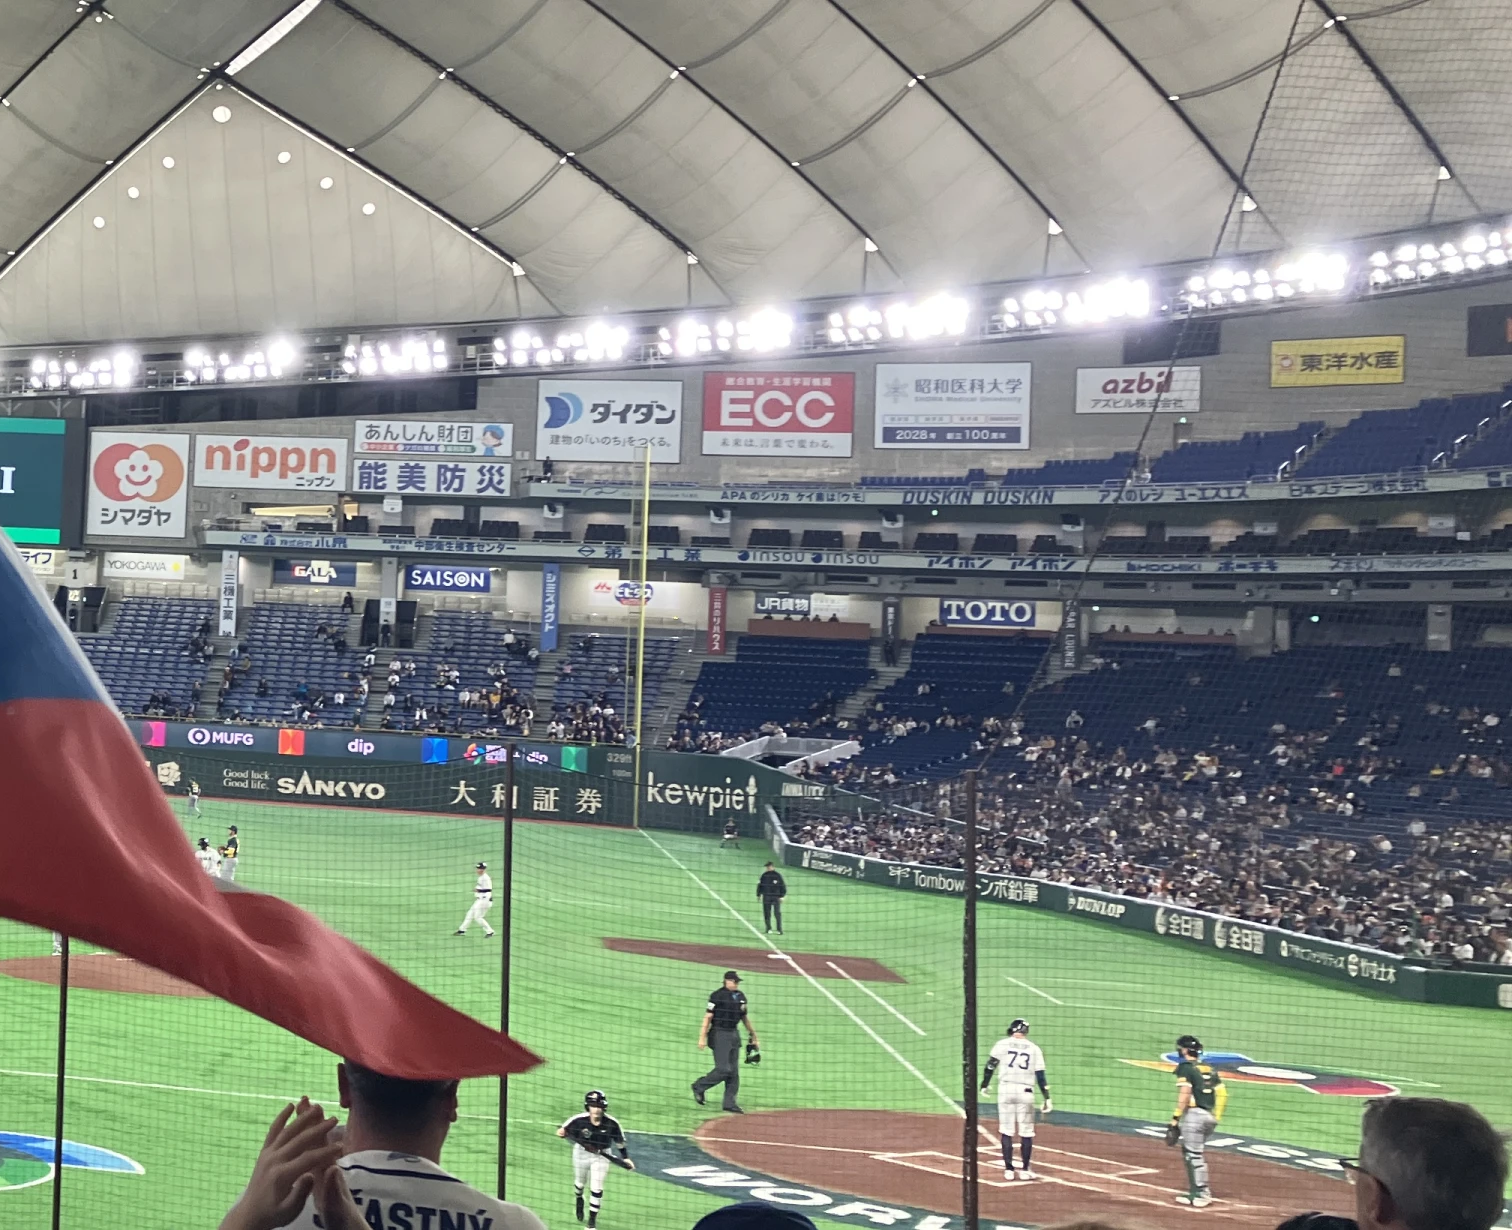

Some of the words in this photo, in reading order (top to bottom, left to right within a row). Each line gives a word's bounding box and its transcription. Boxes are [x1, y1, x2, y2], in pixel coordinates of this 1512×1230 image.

[1300, 351, 1399, 373] 東洋水産
[915, 378, 1023, 394] 昭和医科大学
[1102, 371, 1174, 394] azbil
[590, 400, 676, 424] ダイダン
[720, 390, 835, 428] ECC
[365, 423, 473, 442] あんしん財団
[205, 438, 336, 479] nippn
[295, 475, 335, 488] ニップン
[358, 461, 506, 494] 能美防災
[902, 490, 973, 505] DUSKIN
[983, 490, 1055, 505] DUSKIN
[100, 506, 172, 527] シマダヤ
[72, 568, 79, 580] 1
[107, 559, 167, 572] YOKOGAWA
[293, 565, 338, 579] GALA
[411, 570, 485, 588] SAISON
[757, 596, 809, 612] JR貨物
[944, 601, 1033, 622] TOTO
[212, 731, 254, 746] MUFG
[347, 738, 375, 755] dip
[223, 768, 249, 780] Good
[223, 778, 249, 789] Good
[277, 770, 385, 800] SANKYO
[913, 869, 966, 892] Tombow
[975, 877, 1039, 903] ンボ鉛筆
[1076, 896, 1125, 918] DUNLOP
[1007, 1050, 1030, 1070] 73
[662, 1164, 1030, 1230] WORL
